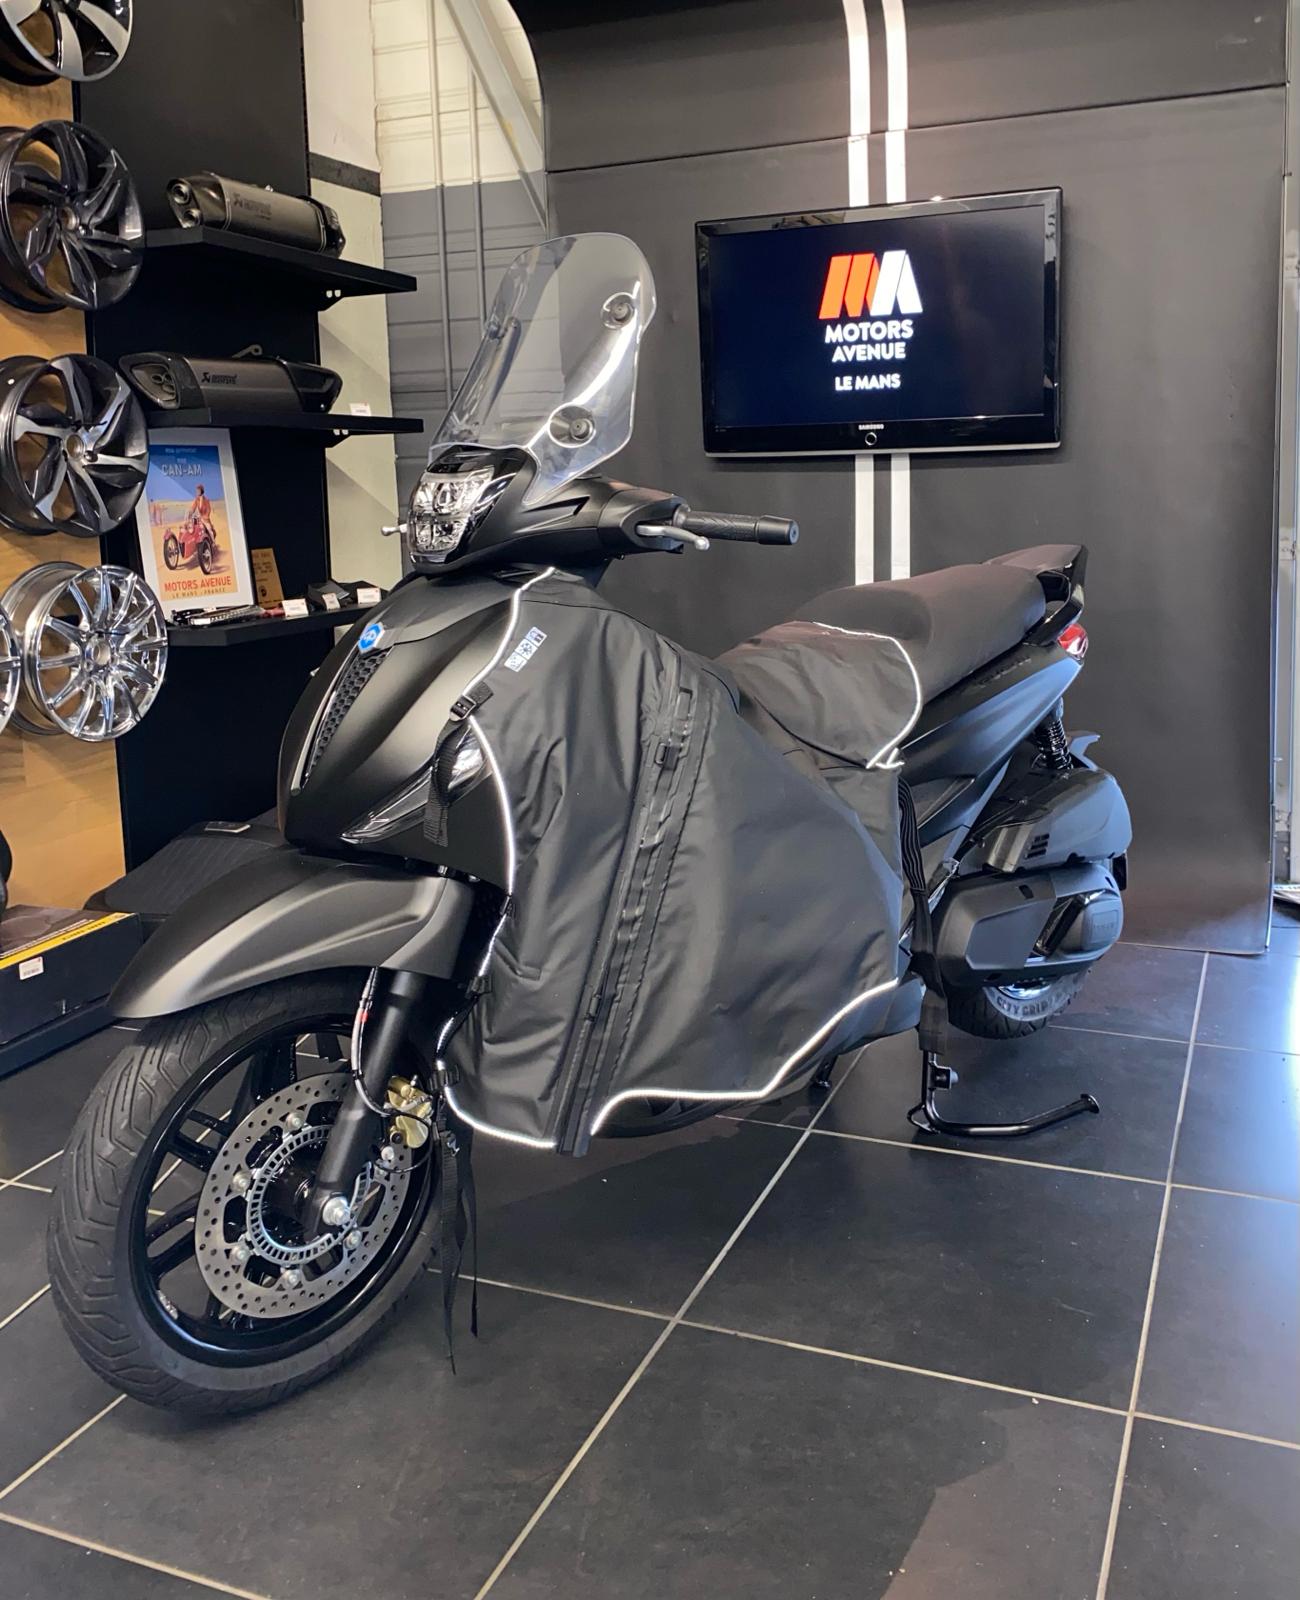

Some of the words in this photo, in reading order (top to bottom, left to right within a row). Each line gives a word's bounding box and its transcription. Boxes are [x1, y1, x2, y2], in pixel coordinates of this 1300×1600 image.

[825, 320, 914, 343] MOTORS
[832, 342, 906, 362] AVENUE
[835, 376, 853, 391] LE
[855, 373, 901, 390] MANS
[161, 463, 203, 476] CAN-AM
[164, 579, 199, 593] MOTORS
[200, 575, 232, 588] AVENUE
[1022, 1000, 1049, 1016] GRIP
